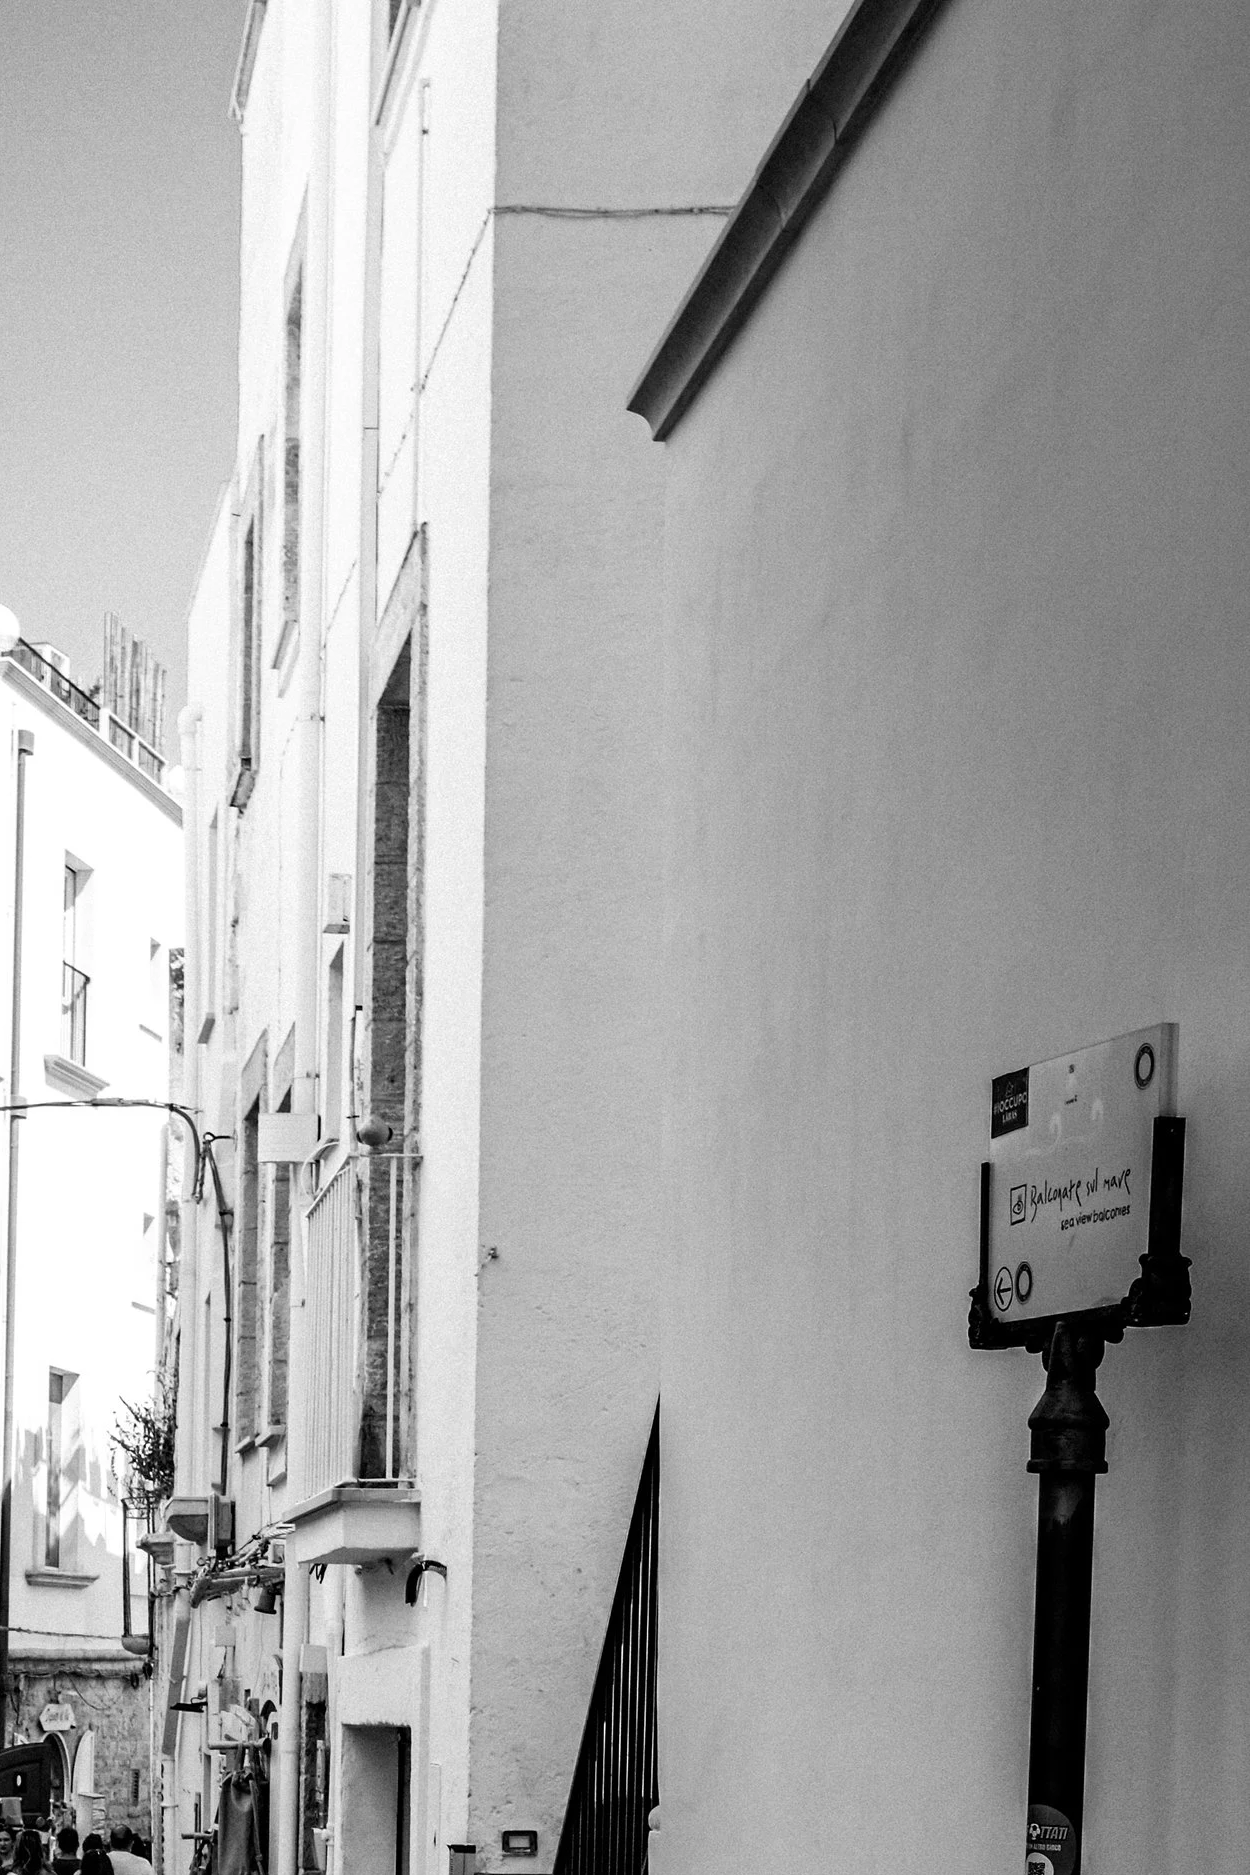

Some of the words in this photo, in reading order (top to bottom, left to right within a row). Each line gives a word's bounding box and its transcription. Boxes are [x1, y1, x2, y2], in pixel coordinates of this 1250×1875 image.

[1103, 1168, 1131, 1196] mare
[1060, 1219, 1075, 1231] sea
[1076, 1211, 1092, 1226] view
[1093, 1204, 1131, 1223] balconies
